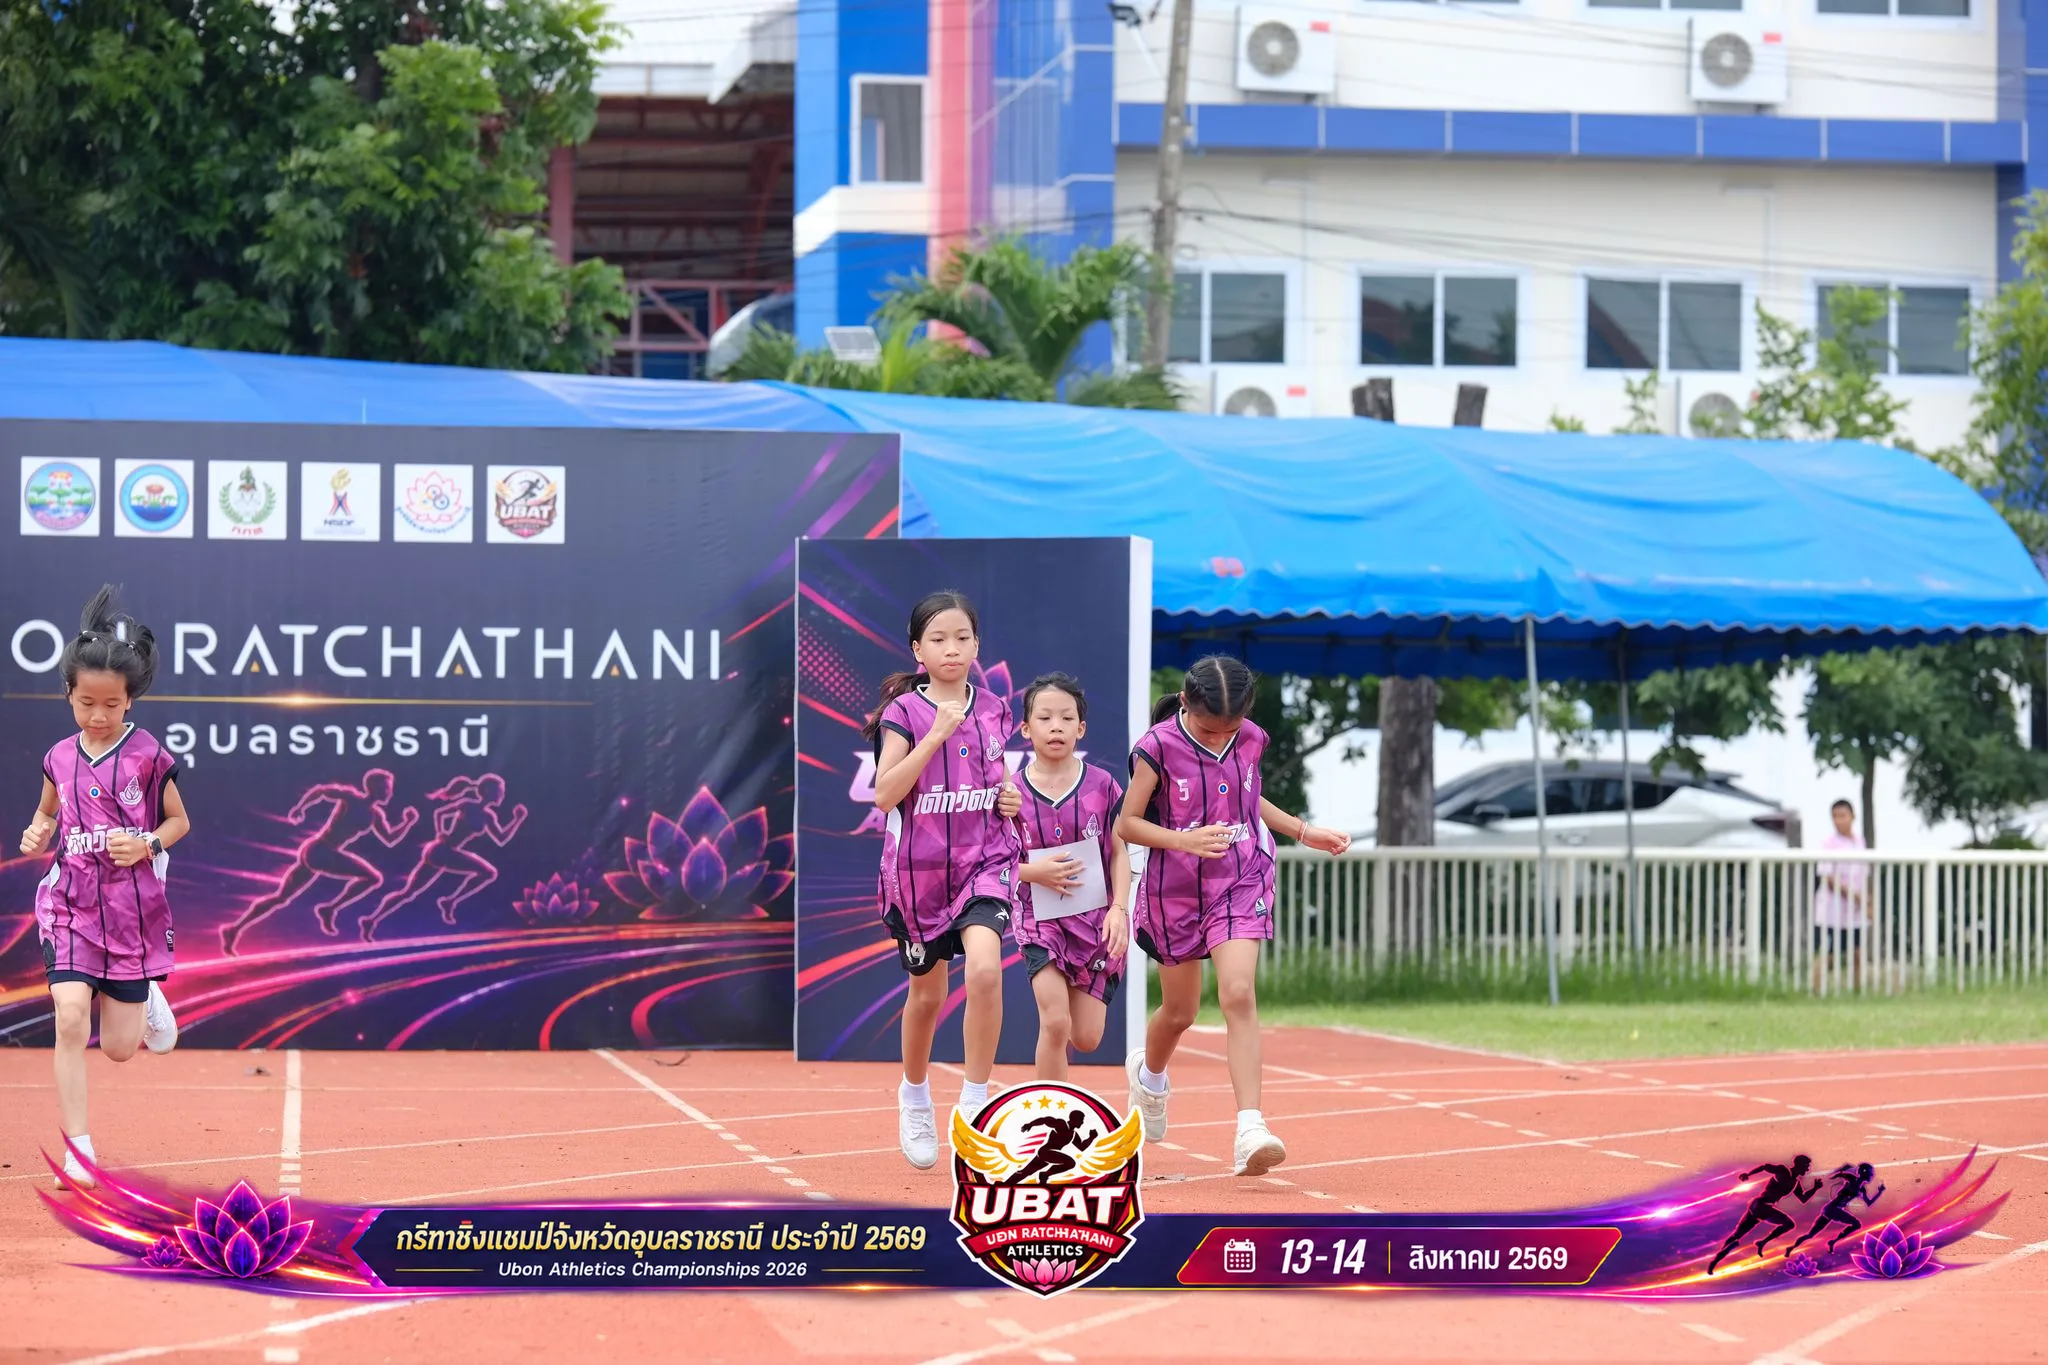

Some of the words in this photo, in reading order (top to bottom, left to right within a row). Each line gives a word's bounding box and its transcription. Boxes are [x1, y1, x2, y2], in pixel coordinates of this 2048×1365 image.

[501, 503, 552, 518] UBAT
[174, 623, 720, 680] RATCHATHANI
[165, 714, 488, 768] อุบลราชธานี
[1177, 778, 1189, 801] 5
